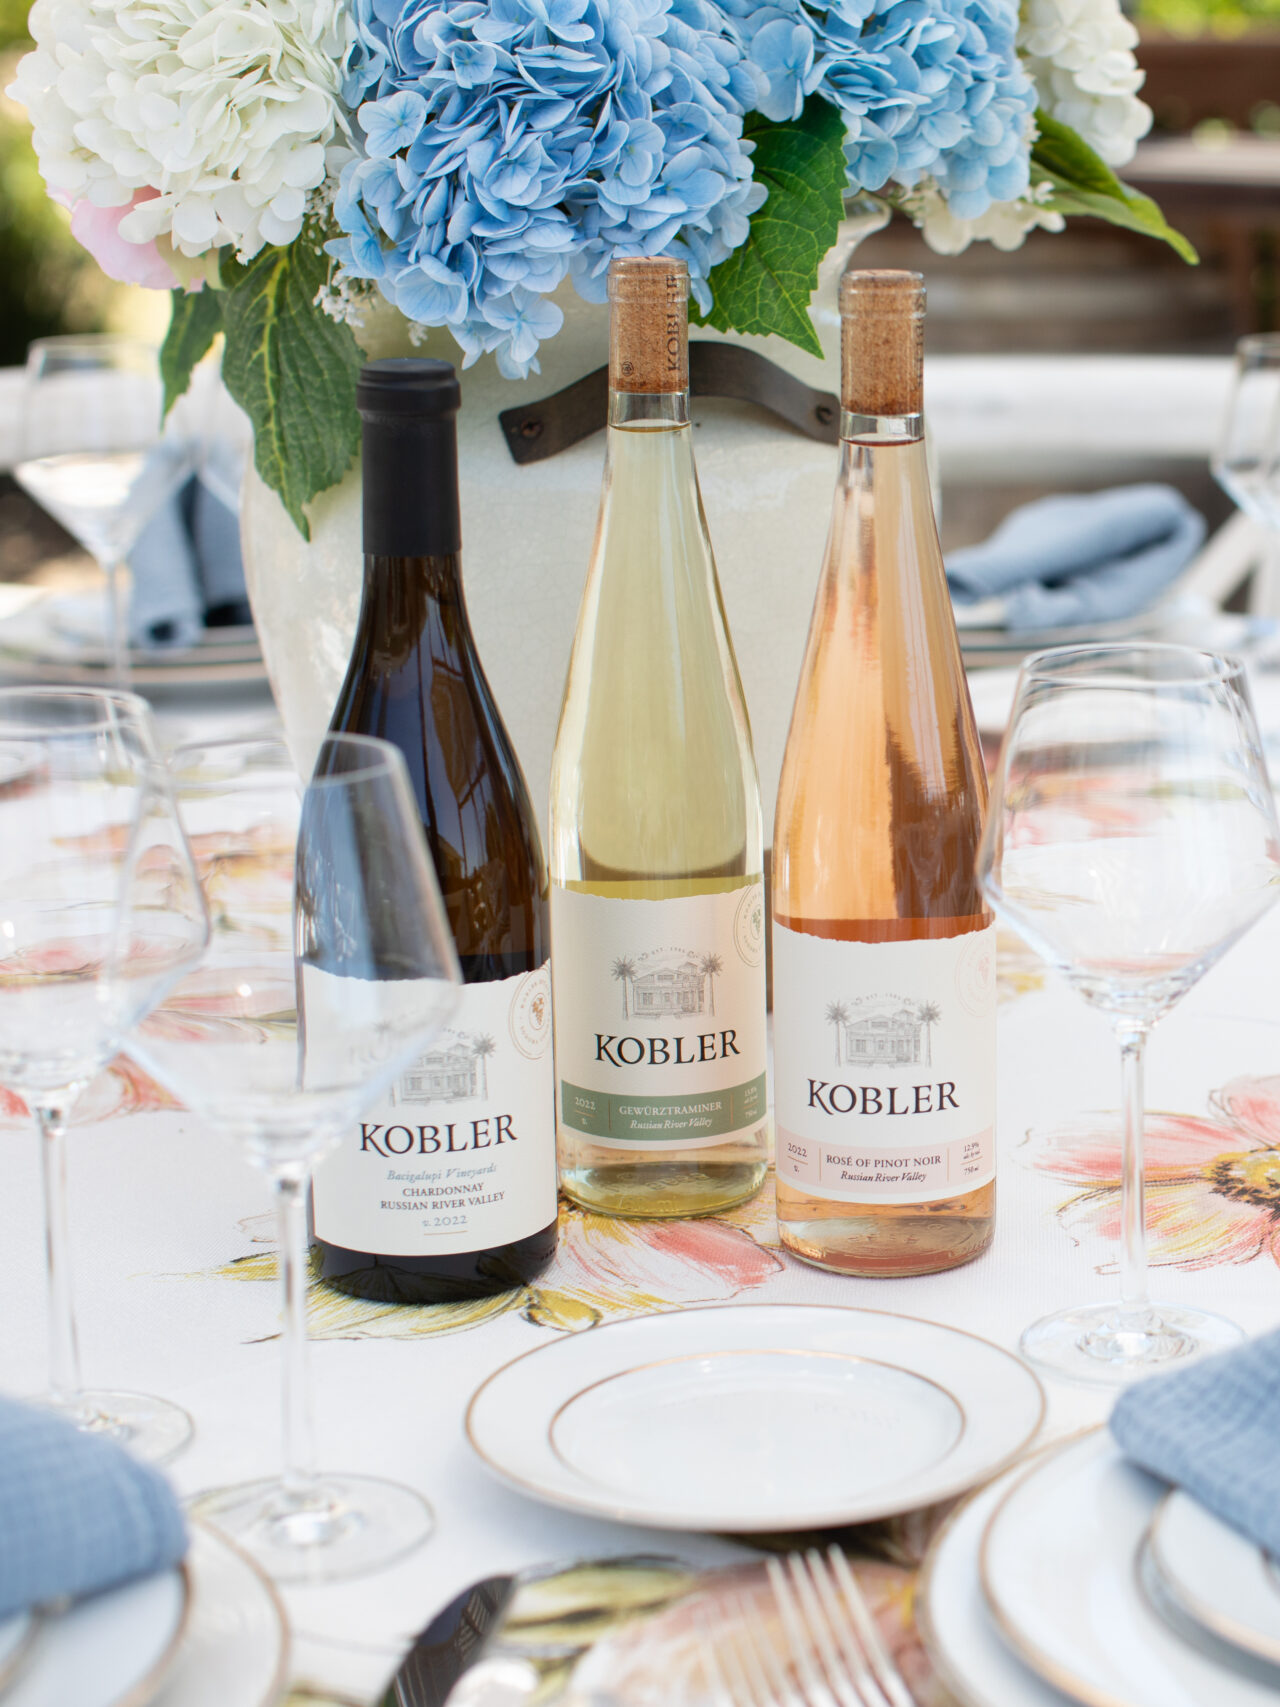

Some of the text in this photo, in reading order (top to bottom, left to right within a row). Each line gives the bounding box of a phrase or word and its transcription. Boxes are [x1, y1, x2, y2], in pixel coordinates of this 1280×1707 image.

[594, 1029, 740, 1068] KOBLER
[574, 1096, 596, 1111] 2022
[808, 1079, 960, 1115] KOBLER
[619, 1100, 722, 1116] GEWÜRZTRAMINER
[630, 1117, 713, 1130] Russian River Valley
[360, 1114, 518, 1158] KOBLER
[787, 1142, 808, 1158] 2022
[826, 1153, 942, 1168] ROSÉ OF PINOT NOIR
[387, 1163, 497, 1183] Bacigalupi Vineyards
[840, 1171, 927, 1183] Russian River Valley
[402, 1182, 485, 1197] CHARDONNAY
[380, 1191, 506, 1210] RUSSIAN RIVER VALLEY
[433, 1215, 468, 1227] 2022
